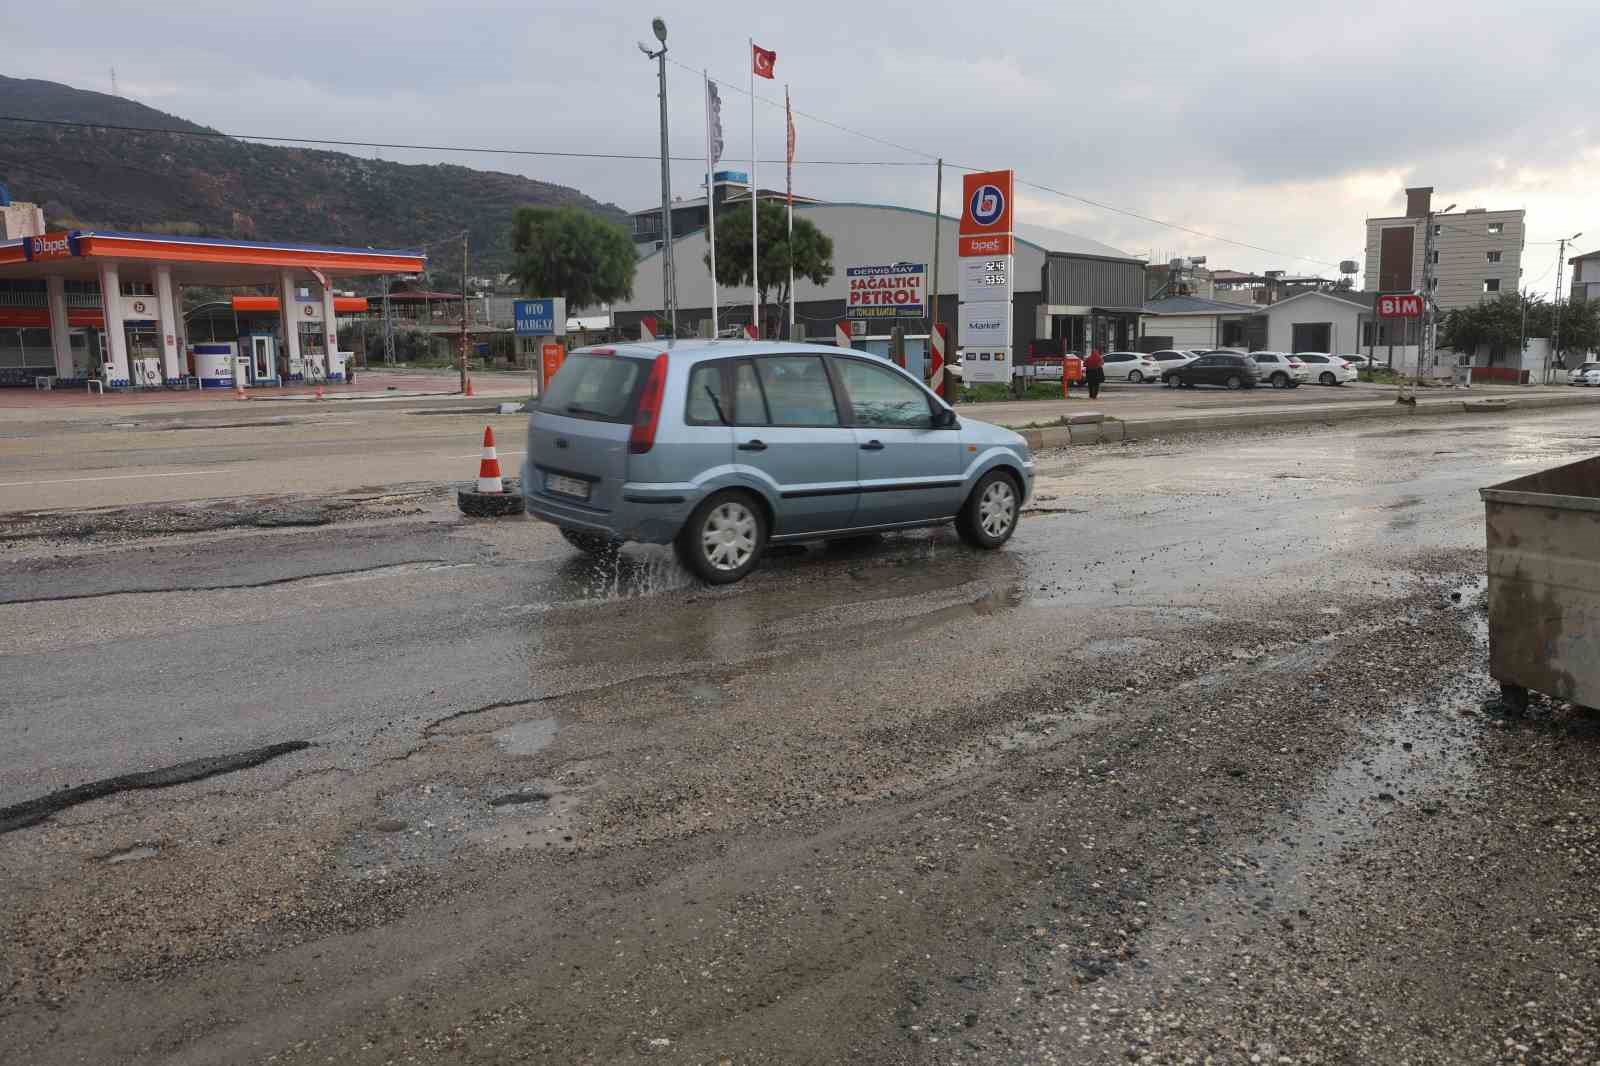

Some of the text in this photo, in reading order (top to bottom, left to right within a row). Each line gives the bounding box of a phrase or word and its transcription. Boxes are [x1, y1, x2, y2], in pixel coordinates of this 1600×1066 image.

[971, 239, 1000, 252] bpet
[849, 289, 920, 304] PETROL
[525, 303, 544, 315] OTO
[1382, 296, 1417, 314] BİM
[968, 319, 1001, 330] Market
